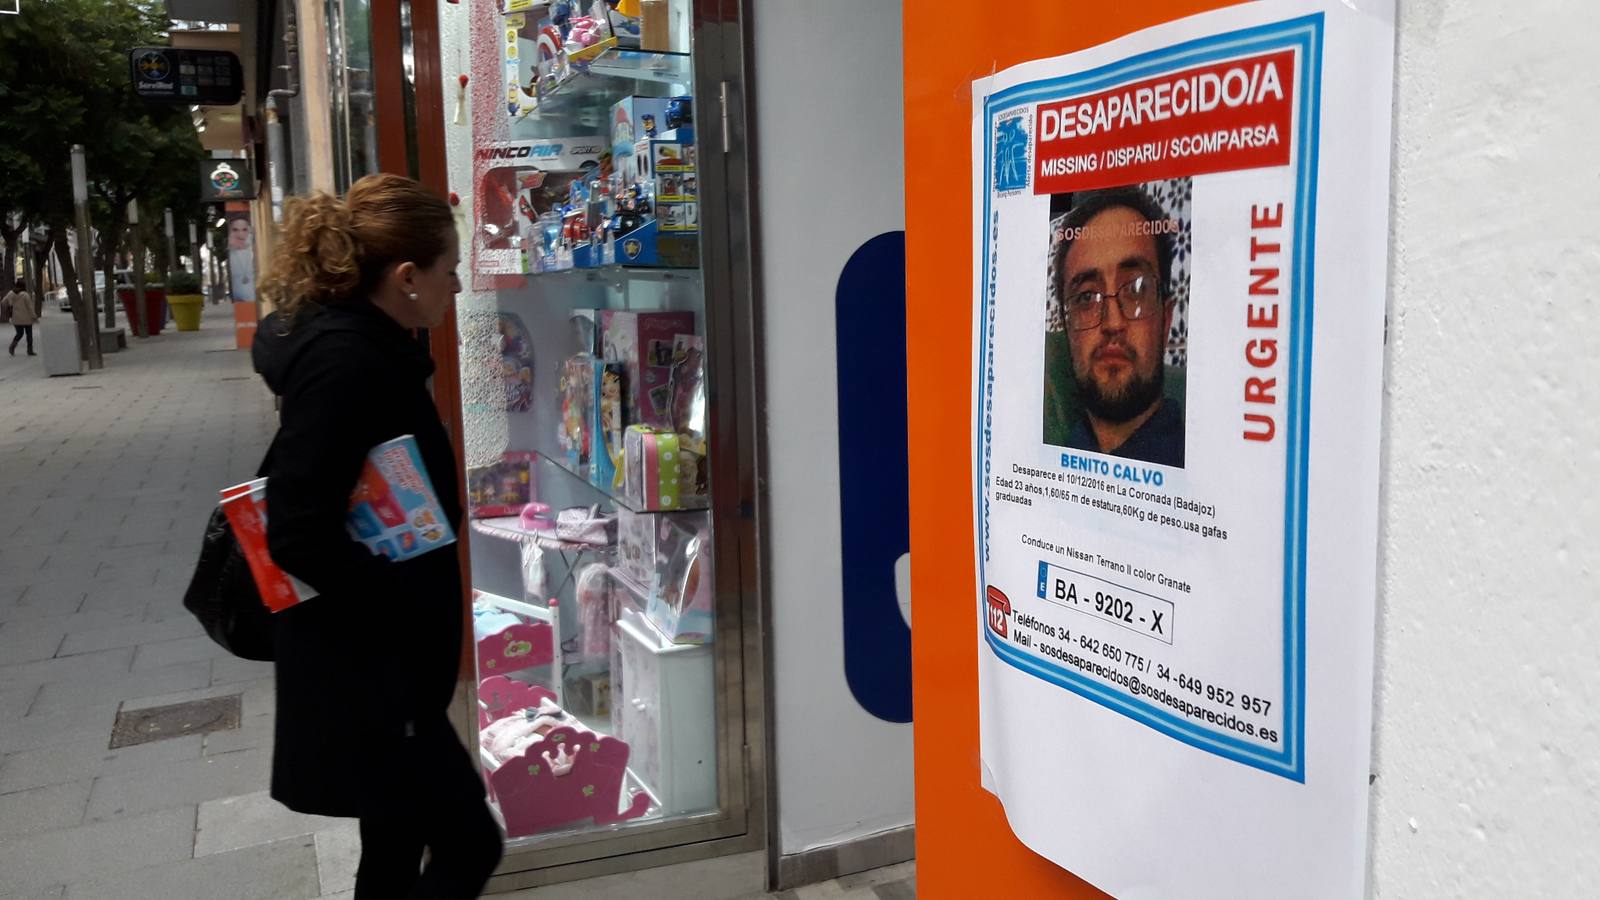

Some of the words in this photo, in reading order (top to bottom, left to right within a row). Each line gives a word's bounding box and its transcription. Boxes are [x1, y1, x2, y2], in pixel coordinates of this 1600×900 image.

[1040, 62, 1284, 142] DESAPARECIDO/A
[1041, 151, 1097, 177] MISSING
[1100, 151, 1104, 170] /
[1107, 143, 1161, 168] DISPARU
[1163, 142, 1168, 160] /
[1170, 124, 1279, 158] SCOMPARSA
[1056, 219, 1179, 240] SOSDESAPARECIDOS
[1243, 203, 1283, 442] URGENTE
[984, 210, 999, 562] www.sosdesaparecidos.es
[995, 491, 1032, 506] graduadas
[1012, 463, 1056, 480] Desaparece
[1058, 473, 1065, 482] el
[1067, 474, 1104, 491] 10/12/2016
[1106, 484, 1115, 494] en
[1117, 484, 1126, 496] La
[1129, 487, 1171, 506] Coronada
[1174, 496, 1215, 519] (Badajoz)
[1061, 453, 1109, 475] BENITO
[1113, 464, 1164, 486] CALVO
[995, 476, 1013, 488] Edad
[1015, 480, 1023, 490] 23
[1071, 495, 1078, 503] m
[1081, 495, 1090, 505] de
[1147, 510, 1158, 522] de
[1202, 525, 1228, 540] gafas
[1021, 534, 1053, 551] Conduce
[1055, 545, 1065, 555] un
[1066, 547, 1094, 563] Nissan
[1096, 555, 1125, 573] Terrano
[1133, 567, 1156, 582] color
[1157, 573, 1191, 593] Granate
[990, 605, 1003, 631] 112
[1040, 582, 1046, 591] E
[1055, 578, 1078, 604] BA
[1095, 592, 1134, 624] 9202
[1150, 610, 1164, 635] X
[1012, 609, 1055, 637] Teléfonos
[1058, 627, 1070, 643] 34
[1080, 635, 1099, 655] 642
[1102, 642, 1122, 663] 650
[1125, 650, 1144, 672] 775
[1157, 664, 1171, 682] 34
[1206, 684, 1234, 707] 952
[1241, 693, 1272, 717] 957
[1013, 629, 1032, 648] Mail
[1040, 641, 1278, 743] sosdesaparecidos@sosdesaparecidos.es
